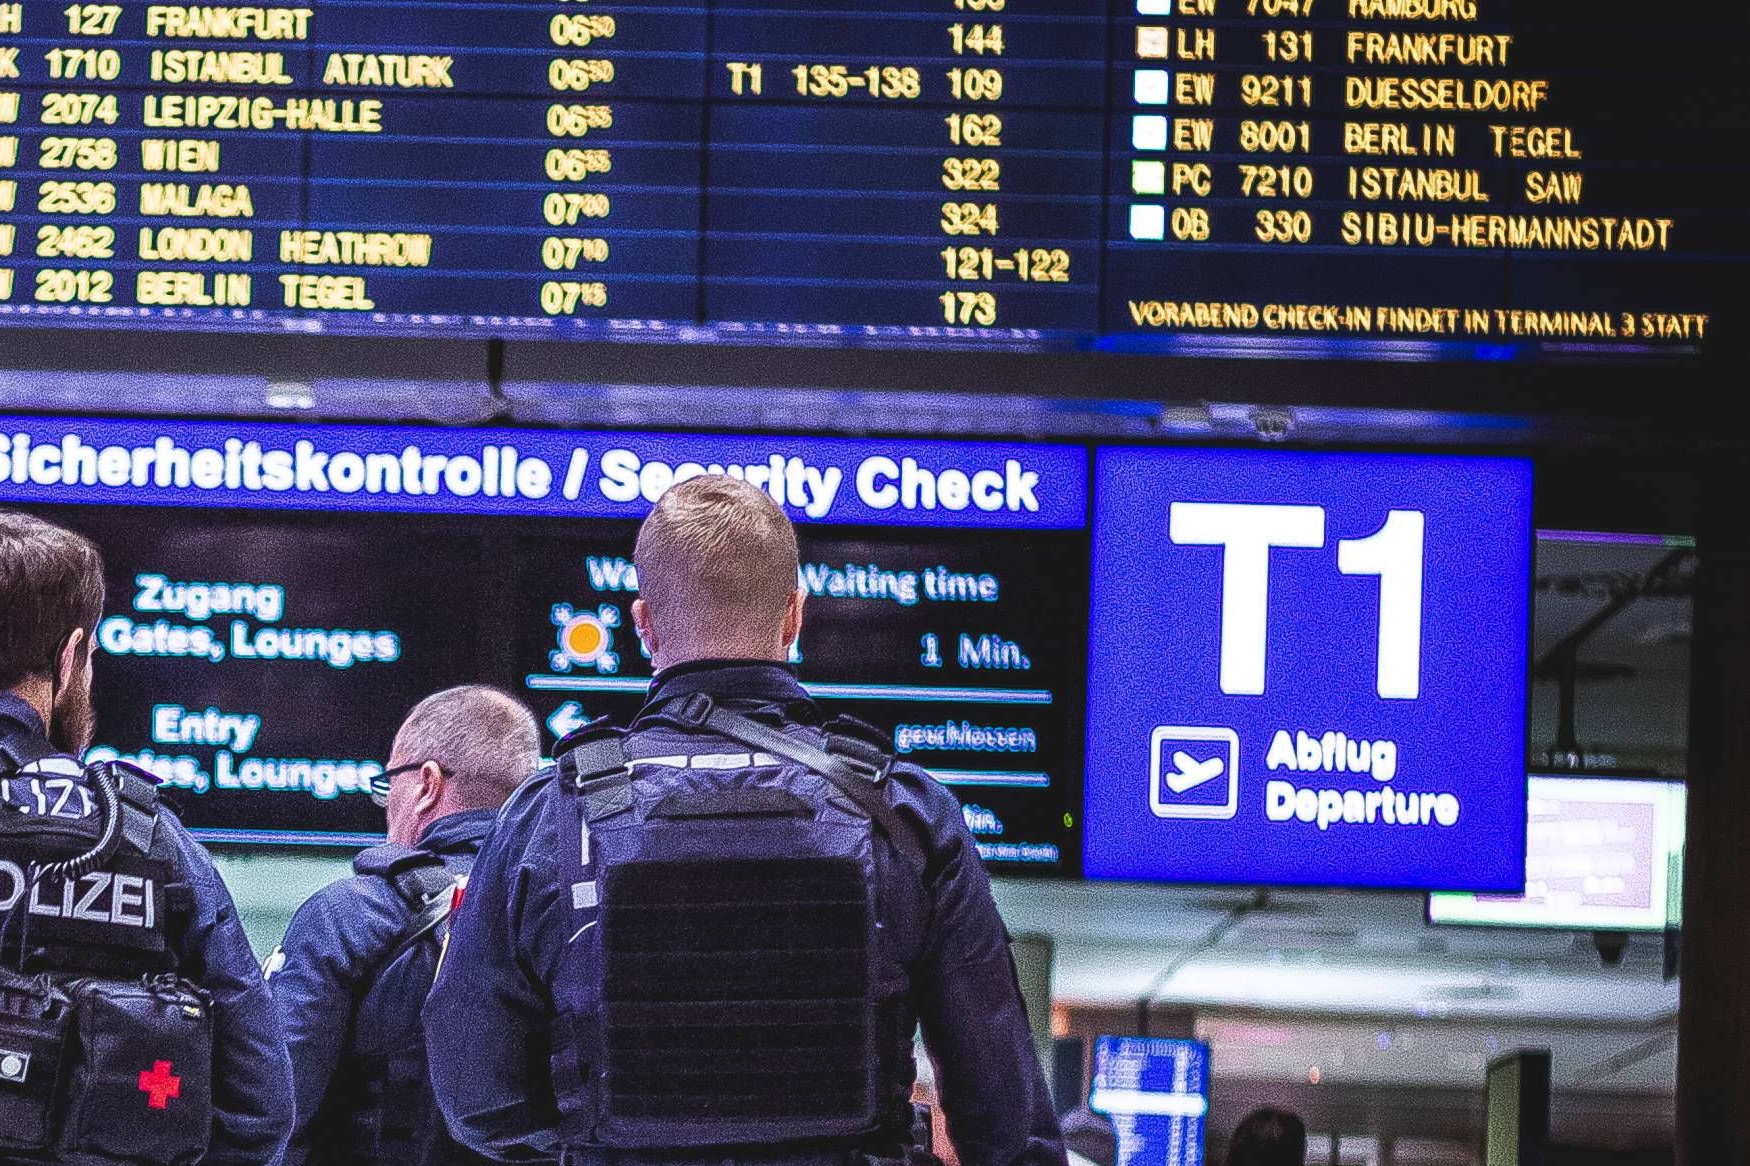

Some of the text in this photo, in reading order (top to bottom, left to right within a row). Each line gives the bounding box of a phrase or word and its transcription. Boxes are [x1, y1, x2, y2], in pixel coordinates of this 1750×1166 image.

[64, 3, 122, 35] 127
[146, 5, 314, 40] FRANKFURT
[947, 23, 1005, 55] 144
[1177, 27, 1511, 66] LH 131 FRANKFURT
[45, 47, 121, 81] 1710
[151, 49, 294, 85] ISTANBUL
[323, 52, 454, 88] ATATURK
[725, 62, 762, 95] T1
[792, 64, 921, 99] 135-138
[946, 67, 1003, 101] 109
[1175, 72, 1546, 111] EW 9211 DUESSELDORF
[41, 92, 119, 125] 2074
[143, 94, 383, 133] LEIPZIG-HALLE
[944, 113, 1002, 146] 162
[1173, 118, 1582, 159] EW 8001 BERLIN TEGEL
[141, 138, 220, 172] WIEN
[941, 157, 1000, 191] 322
[1172, 162, 1582, 204] PC 7210 ISTANBUL SAW
[37, 180, 116, 214] 2536
[139, 182, 254, 218] MALAGA
[940, 202, 1000, 236] 324
[1255, 209, 1312, 243] 330
[1341, 211, 1671, 251] SIBIU-HERMANNSTADT
[36, 224, 115, 258] 2462
[139, 227, 253, 262] LONDON
[280, 230, 433, 267] HEATHROW
[940, 246, 1070, 282] 121-122
[34, 269, 114, 303] 2012
[136, 271, 251, 306] BERLIN
[278, 274, 375, 310] TEGEL
[939, 290, 997, 326] 173
[1128, 300, 1707, 338] VORABEND CHECK-IN FINDET IN TERMINAL 3 STATT
[561, 446, 590, 502] /
[599, 448, 843, 519] Serity
[854, 455, 1042, 513] Check
[133, 573, 285, 622] Zugang
[798, 562, 1000, 606] Waiting time
[1168, 500, 1425, 700] T1
[97, 615, 400, 668] Gates, Lounges
[921, 633, 1030, 669] 1 Min.
[152, 704, 262, 752] Entry
[85, 745, 210, 795] tes,
[1264, 728, 1397, 782] Abflug
[1264, 779, 1461, 831] Departure
